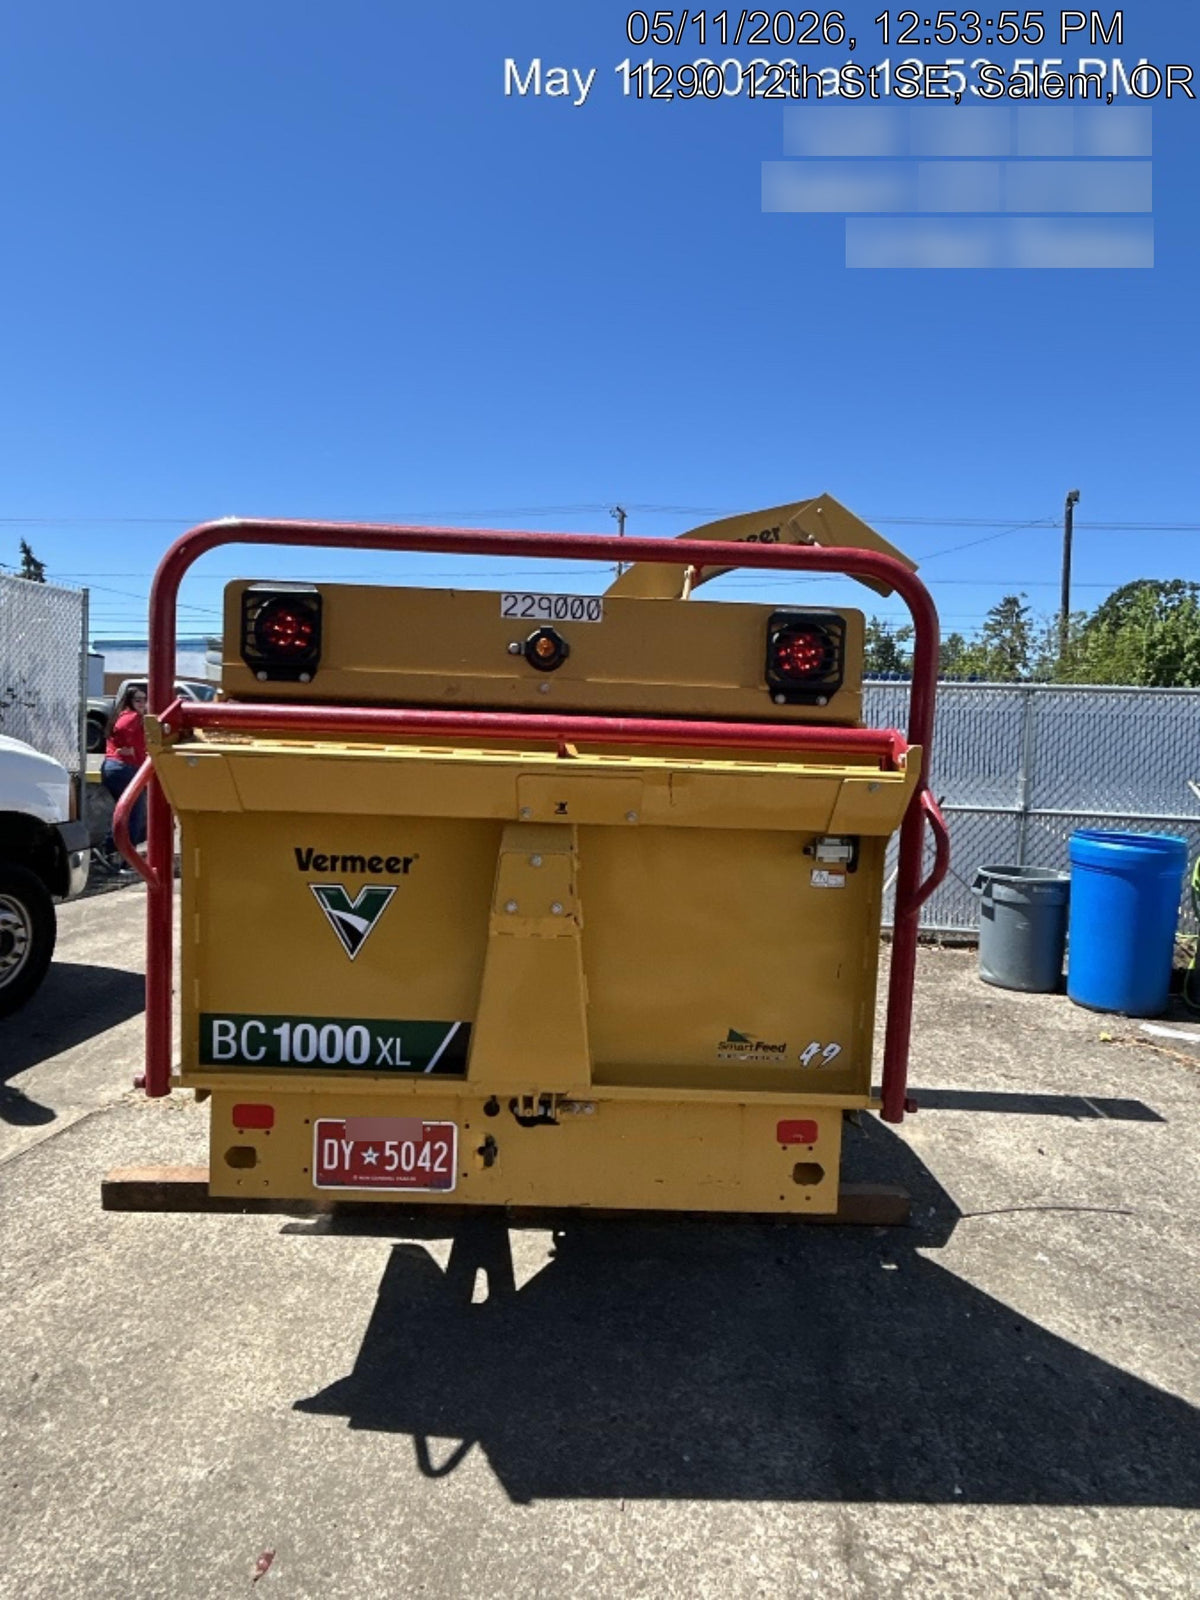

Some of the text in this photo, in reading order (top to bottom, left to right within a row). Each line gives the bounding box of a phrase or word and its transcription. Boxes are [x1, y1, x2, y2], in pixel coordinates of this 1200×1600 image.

[503, 595, 601, 620] 229000
[294, 847, 414, 874] Vermeer
[323, 1138, 448, 1173] DY 5042
